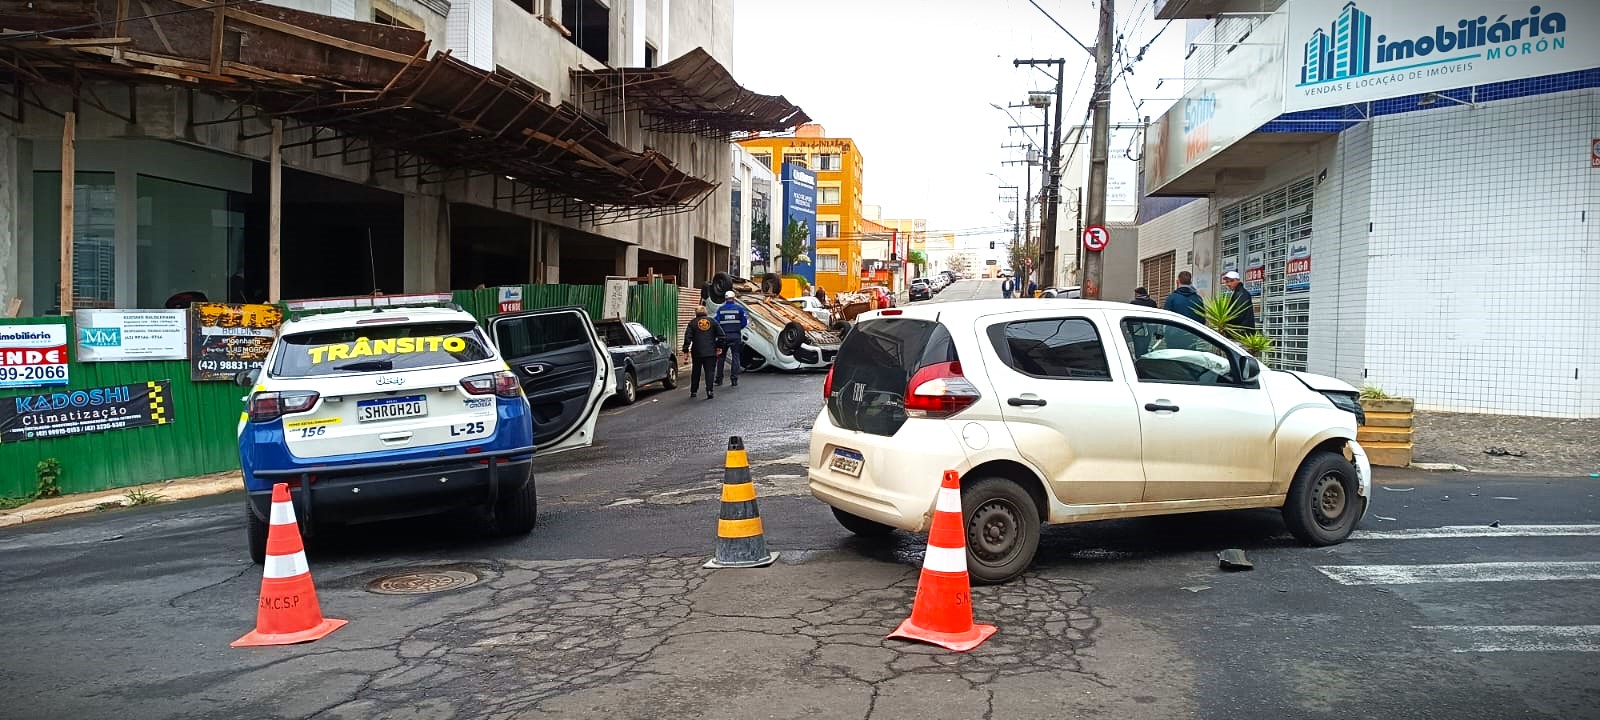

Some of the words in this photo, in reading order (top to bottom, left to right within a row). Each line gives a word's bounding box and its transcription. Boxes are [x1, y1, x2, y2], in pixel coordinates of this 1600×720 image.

[1377, 5, 1566, 63] imobiliária
[1486, 37, 1565, 60] MORÓN
[1305, 83, 1343, 96] VENDAS
[1346, 82, 1352, 90] E
[1355, 74, 1405, 88] LOCAÇÃO
[1408, 70, 1423, 80] DE
[1426, 62, 1474, 77] IMÓVEIS
[1090, 230, 1102, 245] E
[85, 328, 117, 343] MM
[308, 336, 466, 363] TRÂNSITO
[198, 360, 217, 370] (42)
[15, 386, 130, 414] KADOSHI
[22, 407, 127, 426] Climatização
[301, 425, 326, 438] 156
[450, 421, 485, 437] L-25
